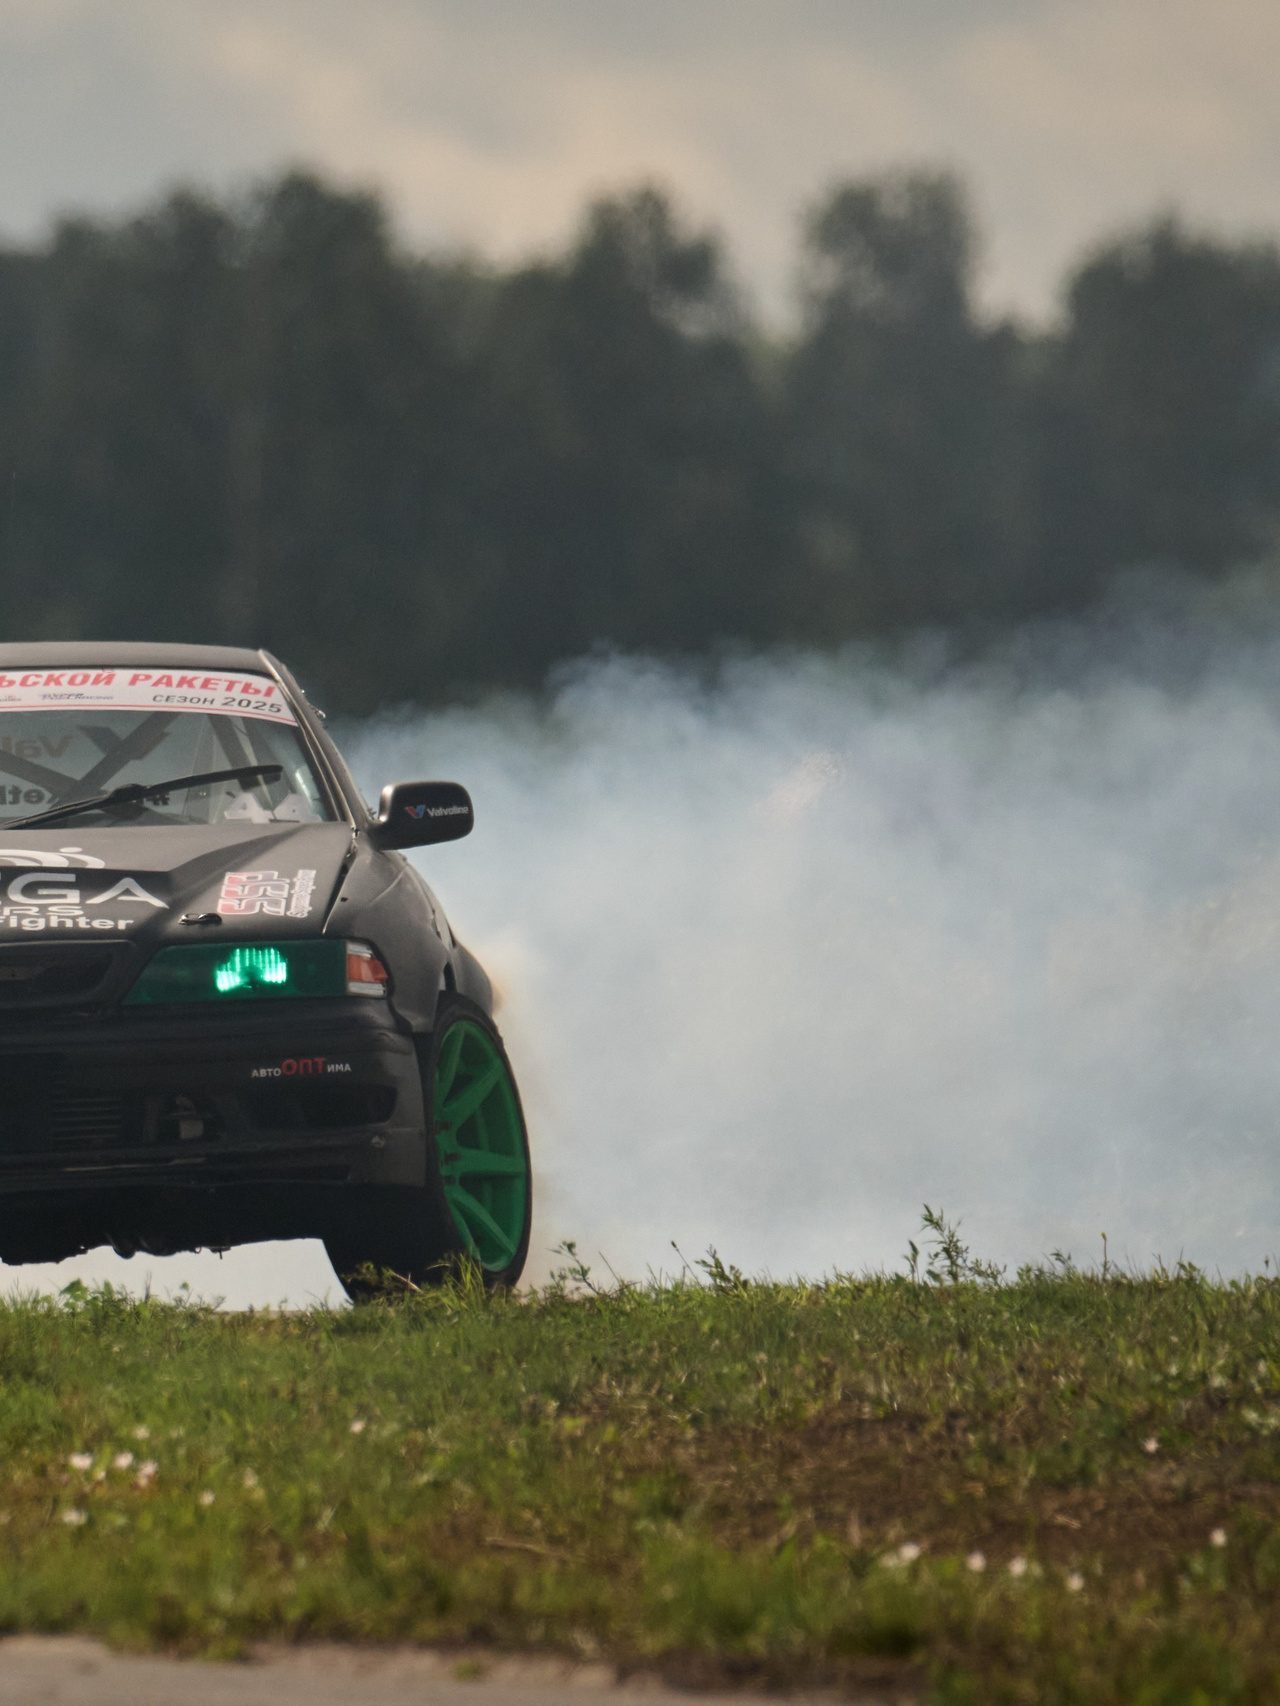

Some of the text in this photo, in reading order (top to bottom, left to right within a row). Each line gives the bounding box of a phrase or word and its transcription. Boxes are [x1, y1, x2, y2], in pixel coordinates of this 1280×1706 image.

[128, 672, 276, 698] РАКЕТЫ
[152, 694, 283, 713] СЕЗОН 2025
[426, 805, 469, 817] Valvoline
